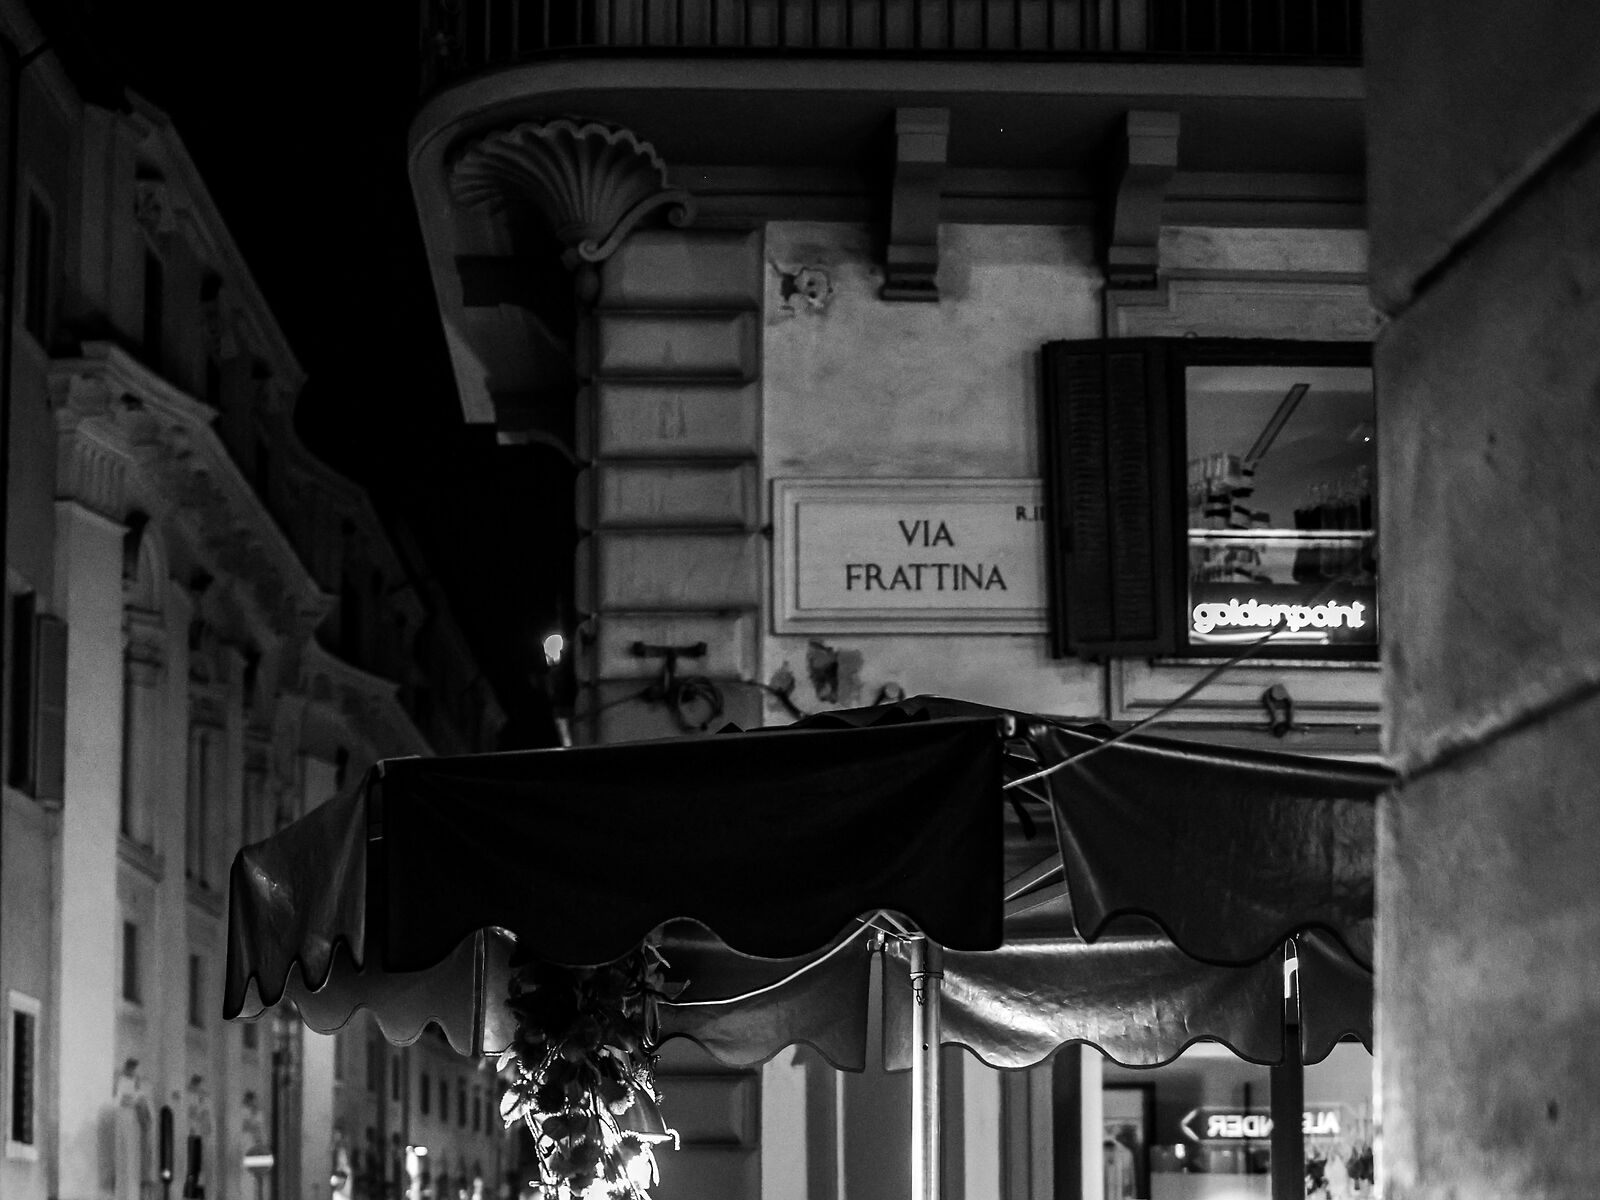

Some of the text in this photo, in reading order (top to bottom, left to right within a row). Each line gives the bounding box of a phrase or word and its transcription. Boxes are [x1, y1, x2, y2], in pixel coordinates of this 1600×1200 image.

[898, 520, 955, 547] VIA
[846, 563, 1008, 591] FRATTINA
[1193, 598, 1366, 634] goldenpoint
